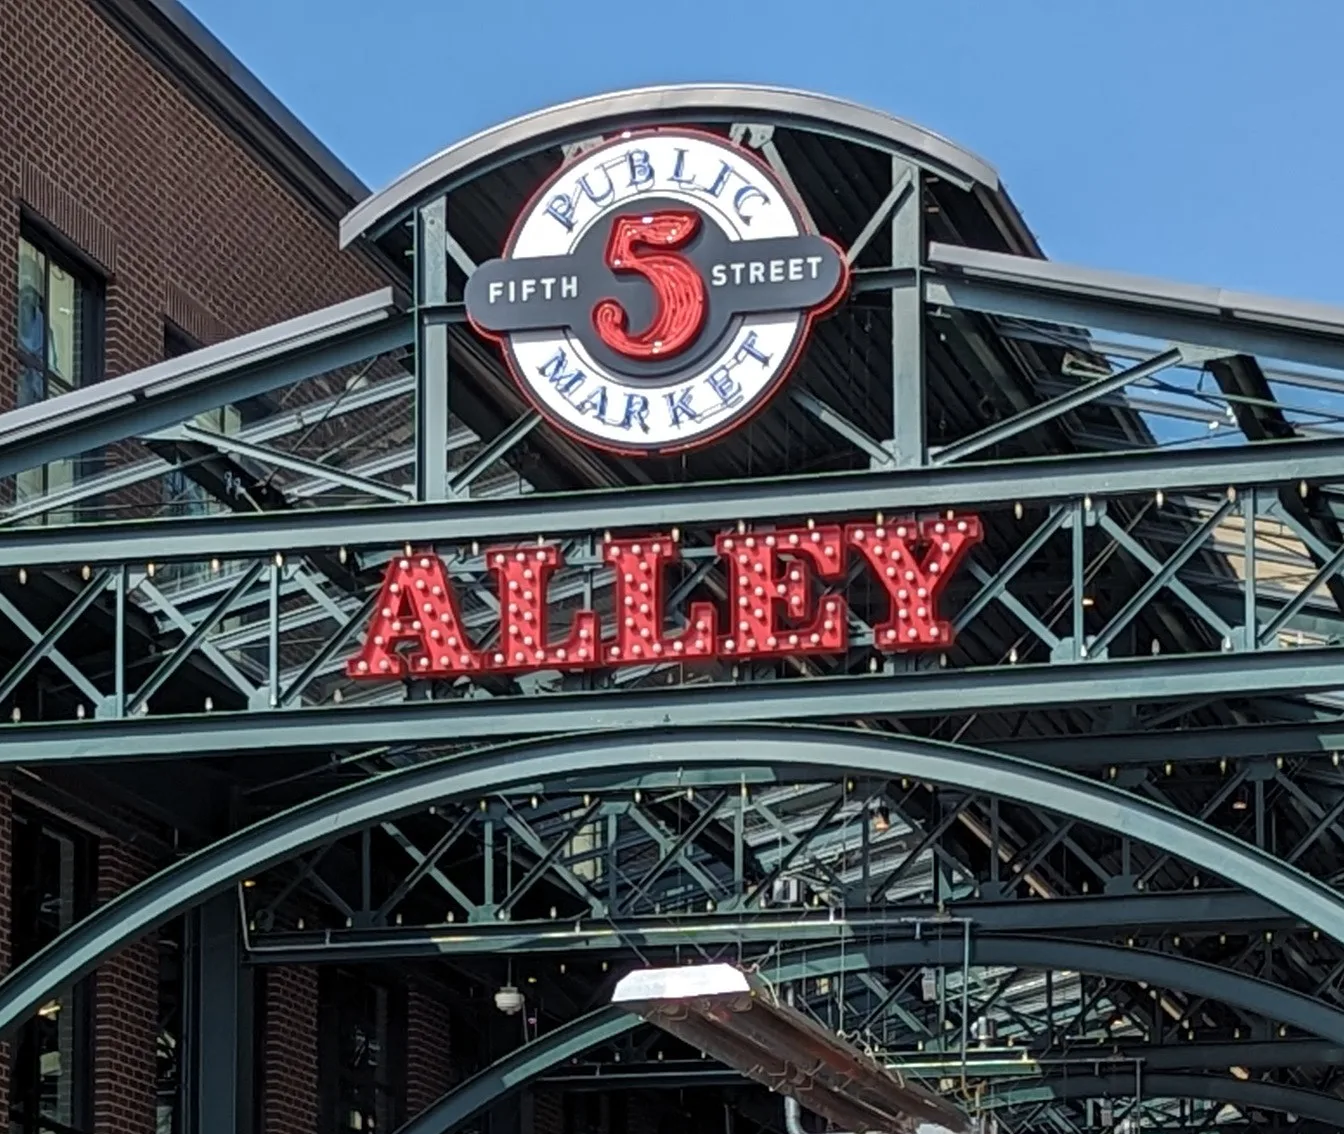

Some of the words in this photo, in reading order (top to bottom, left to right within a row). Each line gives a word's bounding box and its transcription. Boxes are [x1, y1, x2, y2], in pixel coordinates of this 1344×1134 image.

[544, 147, 772, 235] PUBLIC
[488, 275, 579, 304] FIFTH
[590, 208, 709, 362] 5
[710, 256, 825, 287] STREET
[536, 329, 776, 434] MARKET
[346, 514, 984, 680] ALLEY
